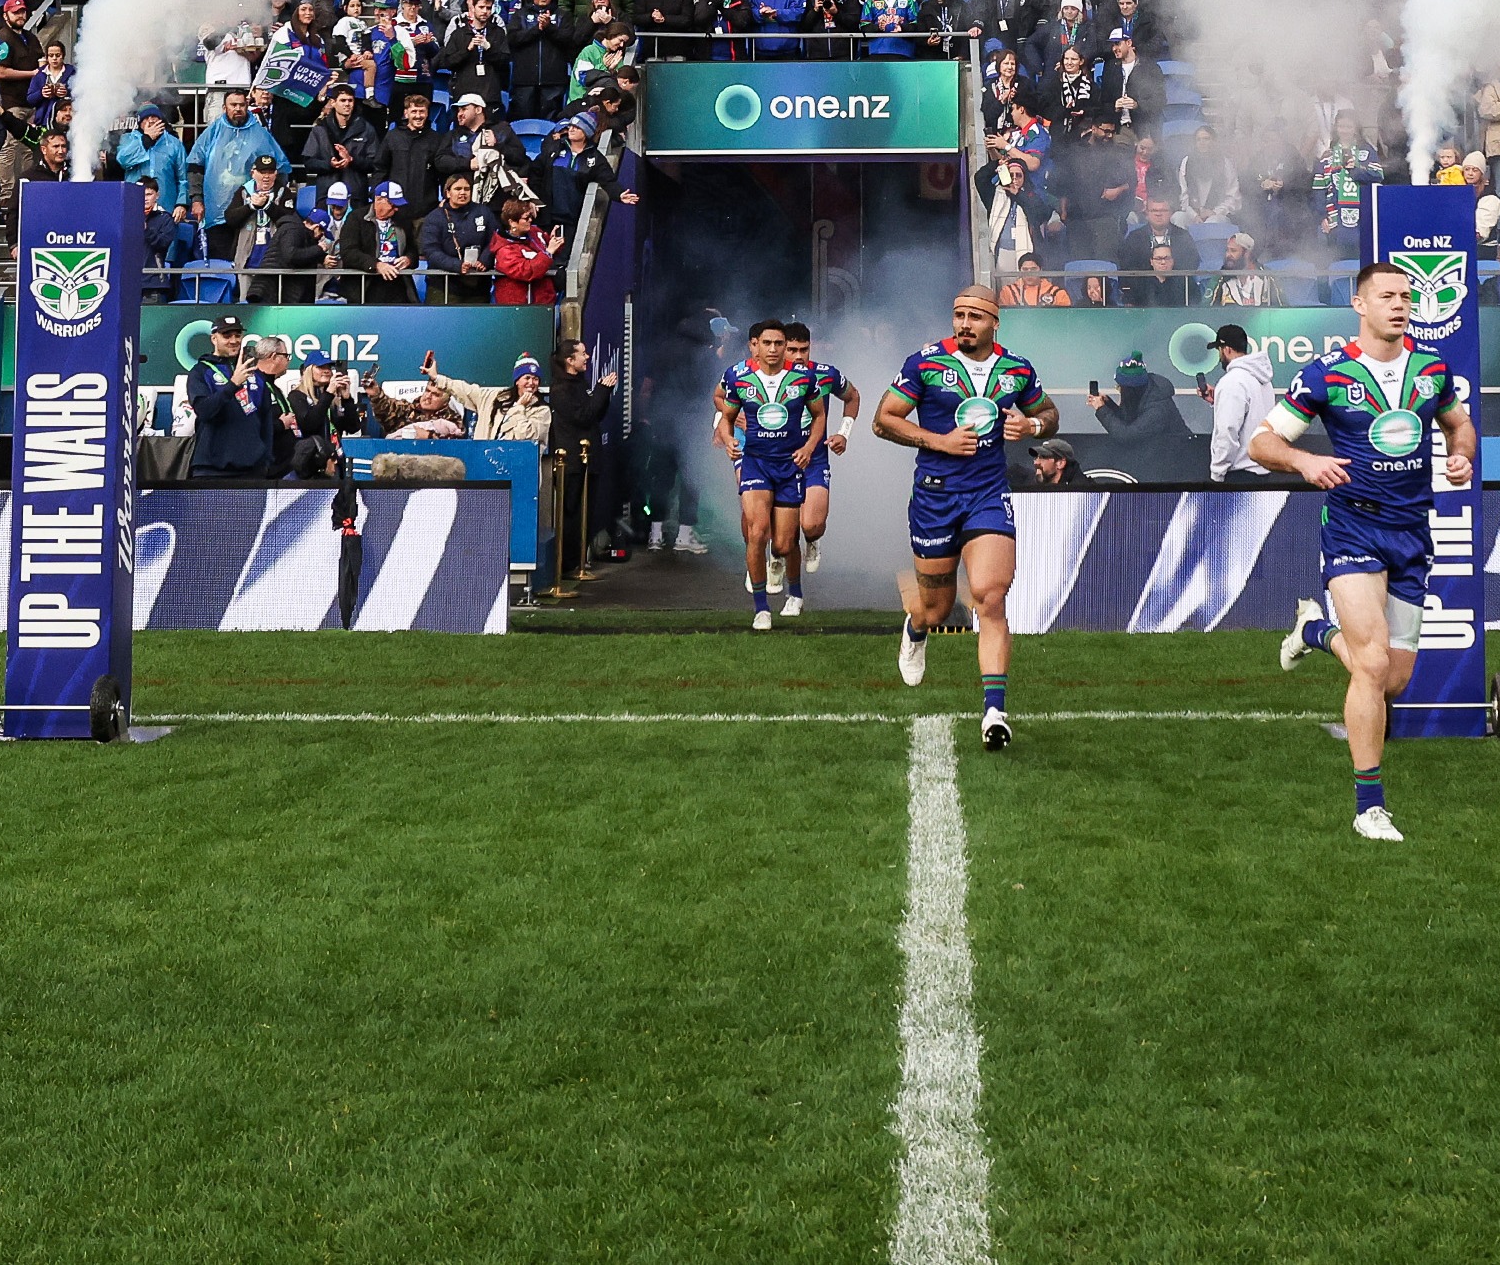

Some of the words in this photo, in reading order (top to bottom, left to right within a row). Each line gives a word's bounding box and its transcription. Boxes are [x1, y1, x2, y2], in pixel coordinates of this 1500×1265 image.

[293, 71, 319, 87] WAHS
[297, 65, 308, 74] UP
[307, 68, 324, 81] THE
[770, 95, 890, 119] one.nz
[46, 231, 74, 245] One
[76, 231, 96, 245] NZ
[1404, 235, 1431, 249] One
[1433, 235, 1452, 249] NZ
[36, 310, 102, 338] WARRIORS
[1404, 315, 1462, 341] ARRIORS
[24, 373, 108, 493] WAHS
[1372, 457, 1423, 472] one.nz
[21, 504, 104, 582] THE
[19, 593, 101, 648] UP
[1417, 594, 1476, 650] UP
